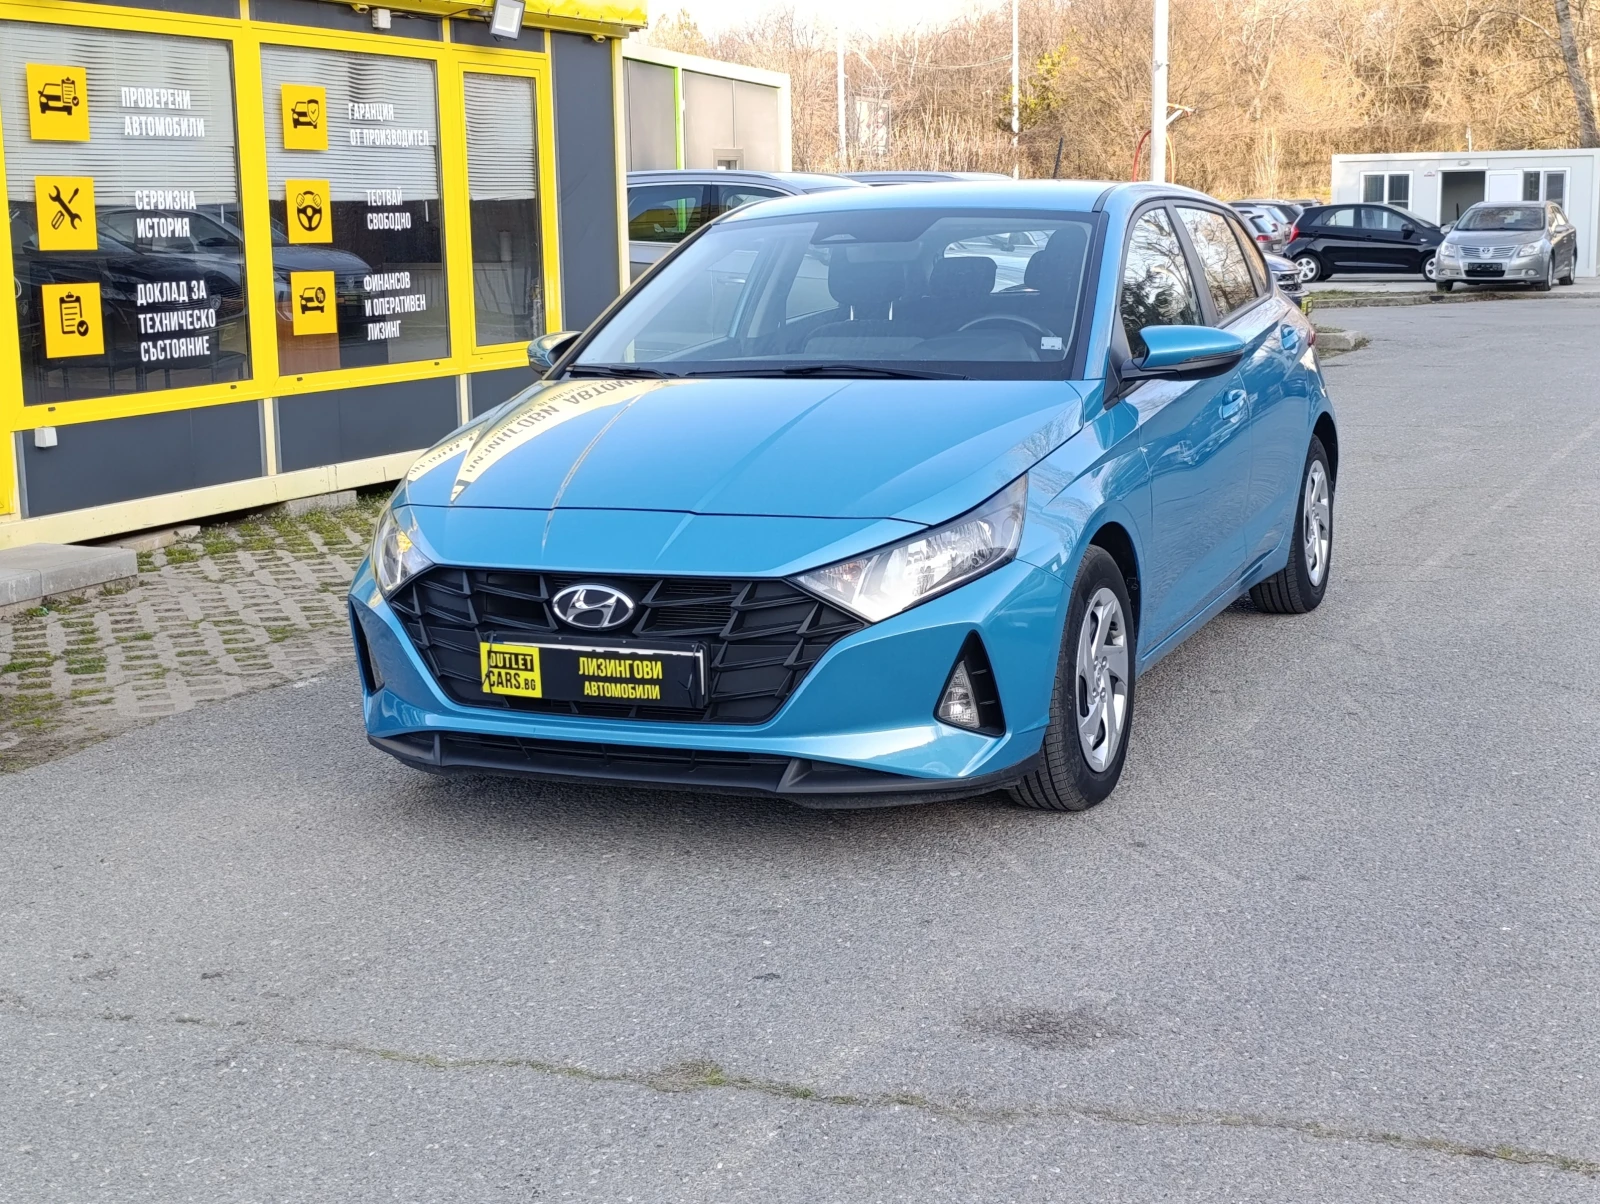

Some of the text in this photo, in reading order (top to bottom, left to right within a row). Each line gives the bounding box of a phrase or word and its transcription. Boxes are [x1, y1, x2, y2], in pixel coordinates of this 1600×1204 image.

[121, 87, 191, 109] ПРОВЕРЕНИ
[348, 103, 394, 122] ГАРАНЦИЯ
[124, 116, 205, 137] АВТОМОБИЛИ
[350, 129, 429, 147] ОТ ПРОИЗВОДИТЕЛ
[135, 190, 197, 210] СЕРВИЗНА
[366, 187, 403, 206] ТЕСТВАЙ
[136, 218, 191, 238] ИСТОРИЯ
[367, 212, 411, 231] СВОБОДНО
[363, 271, 411, 292] ФИНАНСОВ
[136, 280, 207, 306] ДОКЛАД ЗА
[365, 294, 426, 317] И ОПЕРАТИВЕН
[138, 308, 216, 334] ТЕХНИЧЕСКО
[367, 320, 401, 341] ЛИЗИНГ
[140, 335, 211, 362] СЪСТОЯНИЕ
[489, 652, 532, 670] OUTLET
[578, 656, 662, 680] ЛИЗИНГОВИ
[583, 681, 661, 700] АВТОМОБИЛИ
